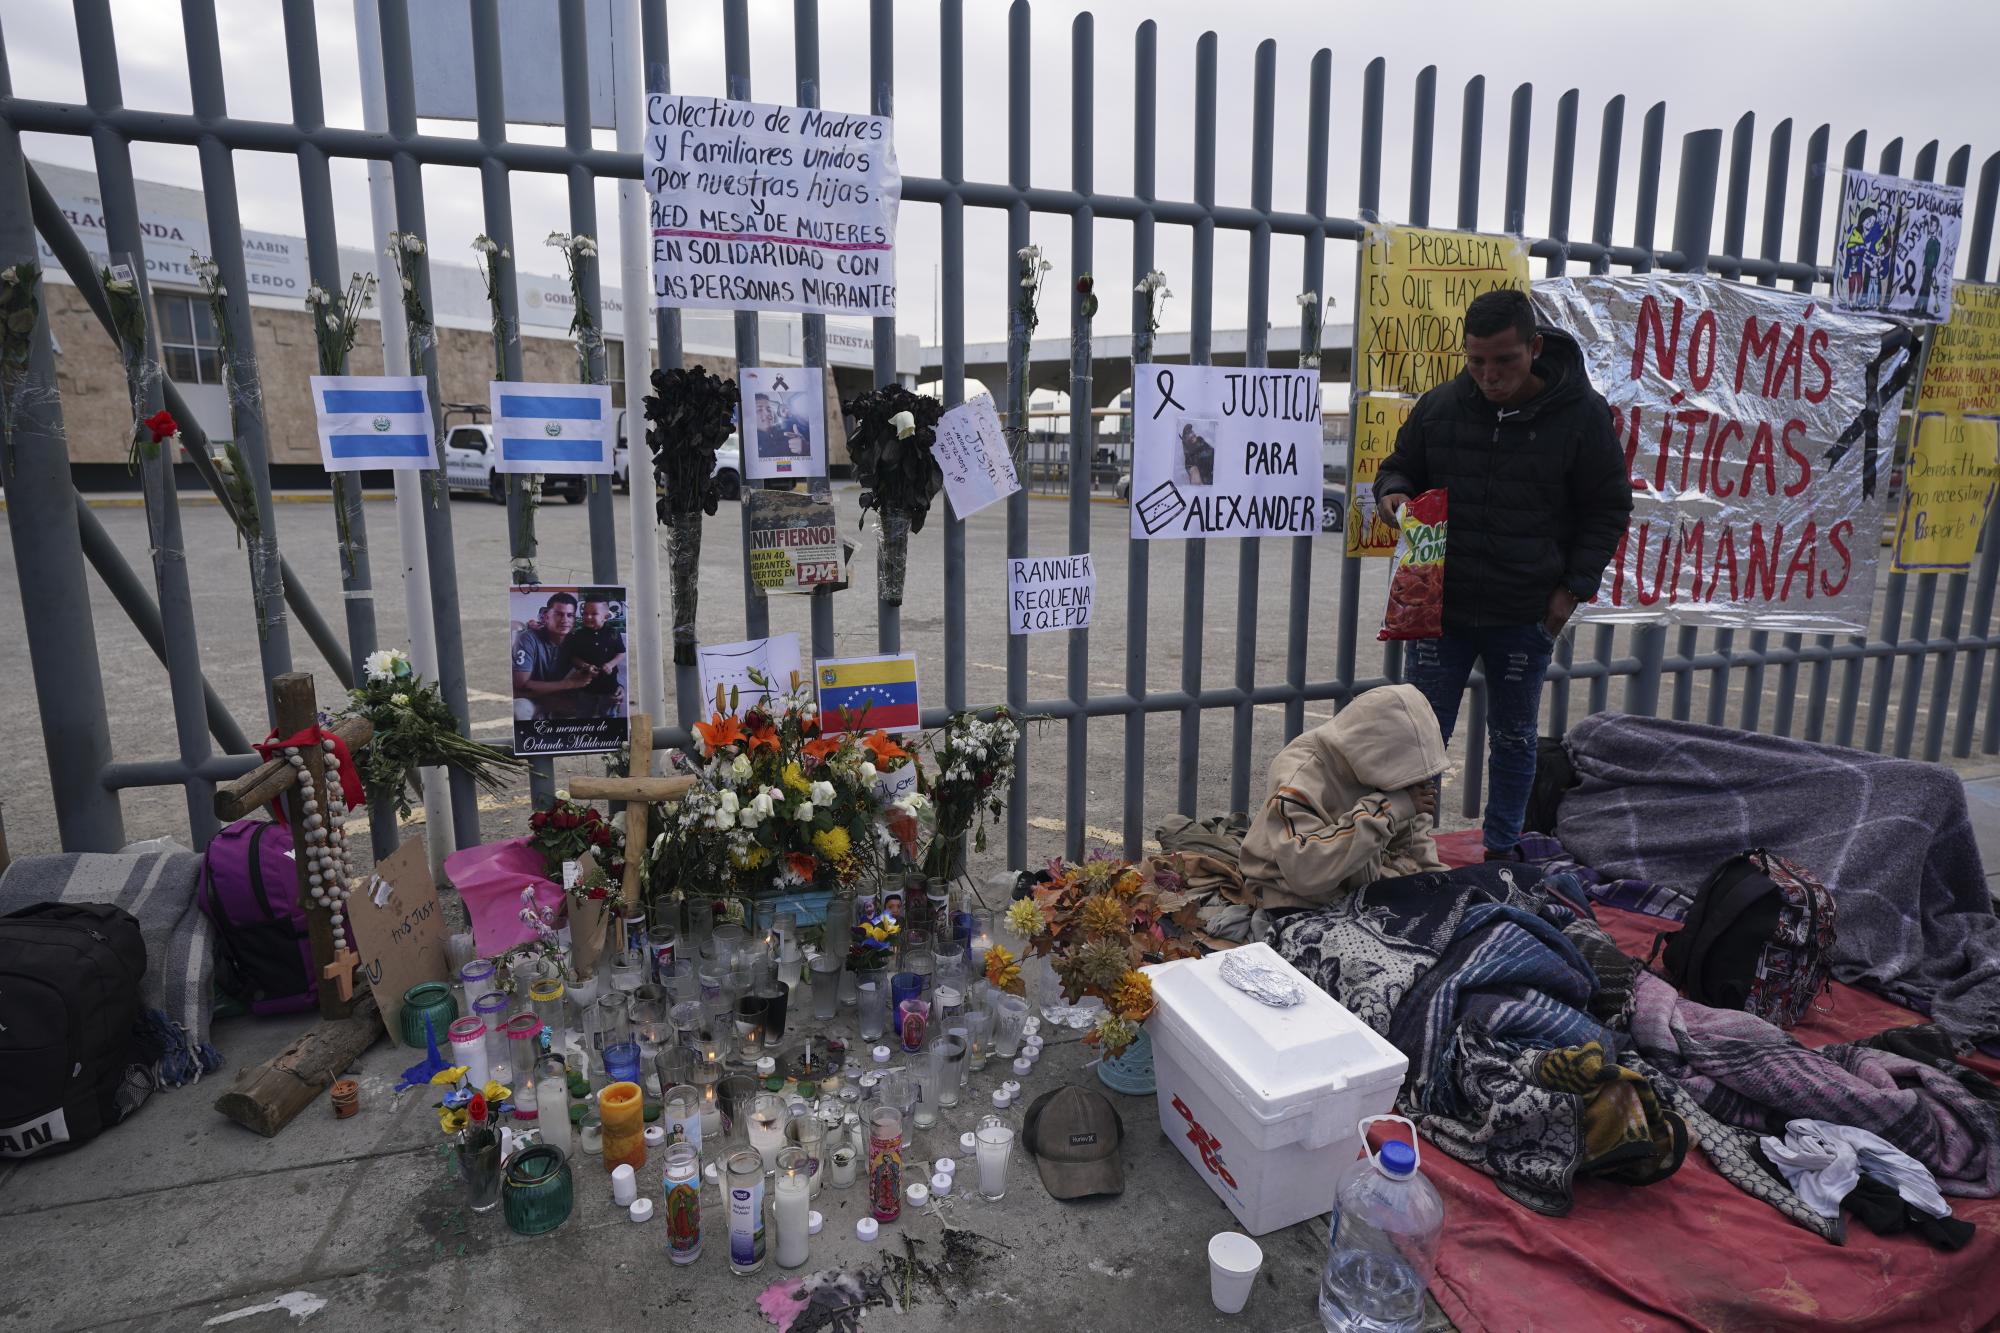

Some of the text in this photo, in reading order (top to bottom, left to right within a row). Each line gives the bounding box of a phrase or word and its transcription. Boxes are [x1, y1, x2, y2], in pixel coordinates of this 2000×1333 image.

[647, 96, 882, 140] Colectivo de Madres
[697, 169, 799, 199] nuestras
[807, 172, 880, 208] hijas.
[1847, 175, 1867, 201] NO
[651, 200, 886, 244] RED MESA DE MUJERES
[654, 240, 879, 276] EN SOLIDARIDAD CON
[1370, 231, 1504, 269] EL PROBLEMA
[653, 275, 897, 309] LAS PERSONAS MIGRANTES
[1369, 274, 1390, 307] ES
[1402, 274, 1434, 311] QUE
[1445, 277, 1482, 313] HAY
[1367, 313, 1467, 352] XENÓFOBO
[1631, 294, 1833, 405] NO MÁS
[1222, 374, 1322, 425] JUSTICIA
[1365, 402, 1385, 426] La
[1361, 430, 1380, 453] de
[1245, 441, 1298, 475] PARA
[1183, 495, 1316, 532] ALEXANDER
[752, 526, 836, 549] NMFIERNO!
[752, 560, 791, 571] IGRANTES
[774, 552, 785, 560] 40
[752, 569, 796, 580] UERTOS EN
[799, 563, 836, 582] PM
[1014, 586, 1091, 611] REQUENA
[516, 650, 526, 666] 3
[523, 734, 622, 751] Orlando Maldonado
[533, 720, 608, 735] En memoria de
